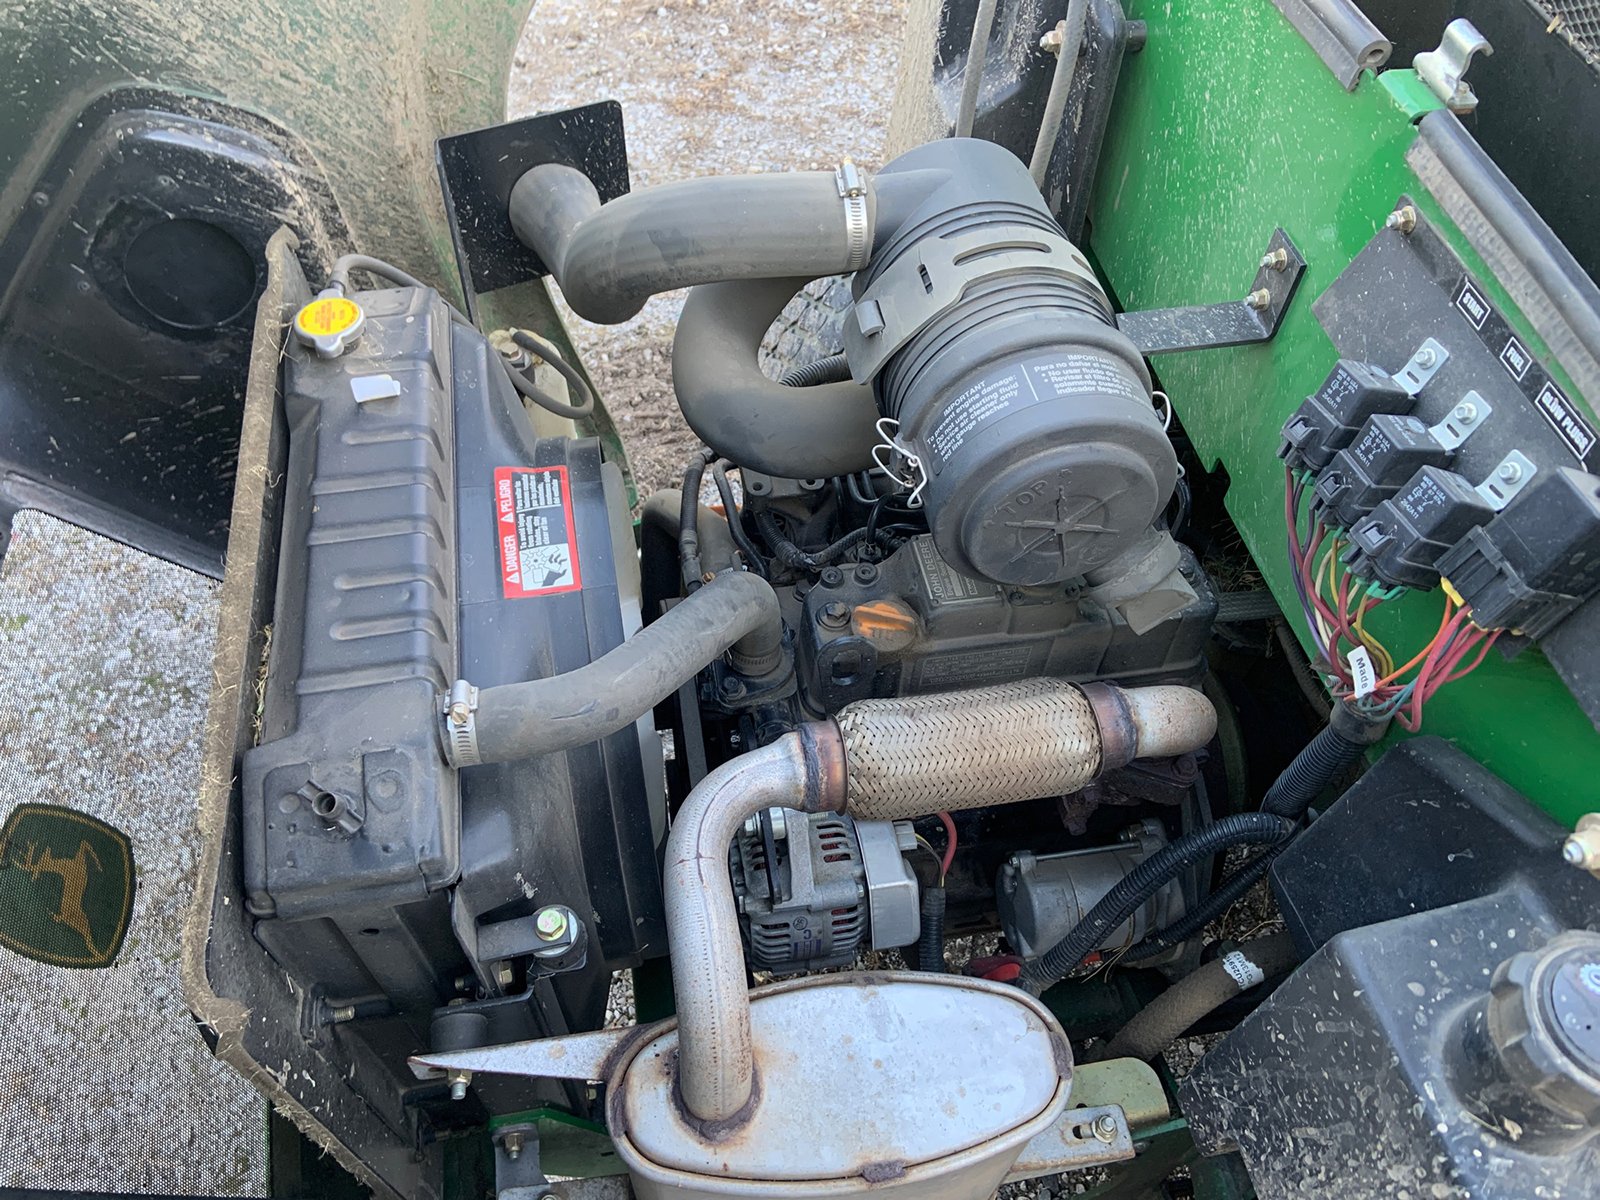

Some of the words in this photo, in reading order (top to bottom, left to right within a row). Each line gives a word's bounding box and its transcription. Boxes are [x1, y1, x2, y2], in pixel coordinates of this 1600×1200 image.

[1462, 291, 1485, 321] START
[1034, 364, 1055, 373] Para
[1506, 346, 1524, 372] FUEL
[1051, 374, 1082, 382] Revisar
[1054, 380, 1097, 388] solamente
[1056, 386, 1095, 395] indicador
[927, 436, 934, 445] To
[934, 411, 956, 438] prevent
[956, 393, 980, 414] engine
[981, 374, 1016, 395] damage:
[936, 434, 944, 445] Do
[944, 423, 955, 435] not
[955, 411, 968, 424] use
[968, 391, 998, 412] starting
[999, 381, 1019, 394] fluid
[943, 380, 986, 416] IMPORTANT
[938, 426, 959, 450] Service
[960, 418, 969, 428] air
[970, 399, 998, 419] cleaner
[1000, 390, 1018, 402] only
[940, 438, 956, 456] when
[955, 420, 977, 440] gauge
[978, 400, 1009, 422] reaches
[1542, 391, 1566, 421] GLOW
[1561, 416, 1589, 453] PLUGS
[942, 450, 952, 462] red
[952, 438, 964, 451] line
[499, 479, 512, 512] PELIGRO
[997, 480, 1048, 514] TOP
[504, 534, 518, 572] DANGER
[920, 541, 935, 570] DEERE
[930, 573, 945, 598] JOHN
[1356, 657, 1368, 688] Made
